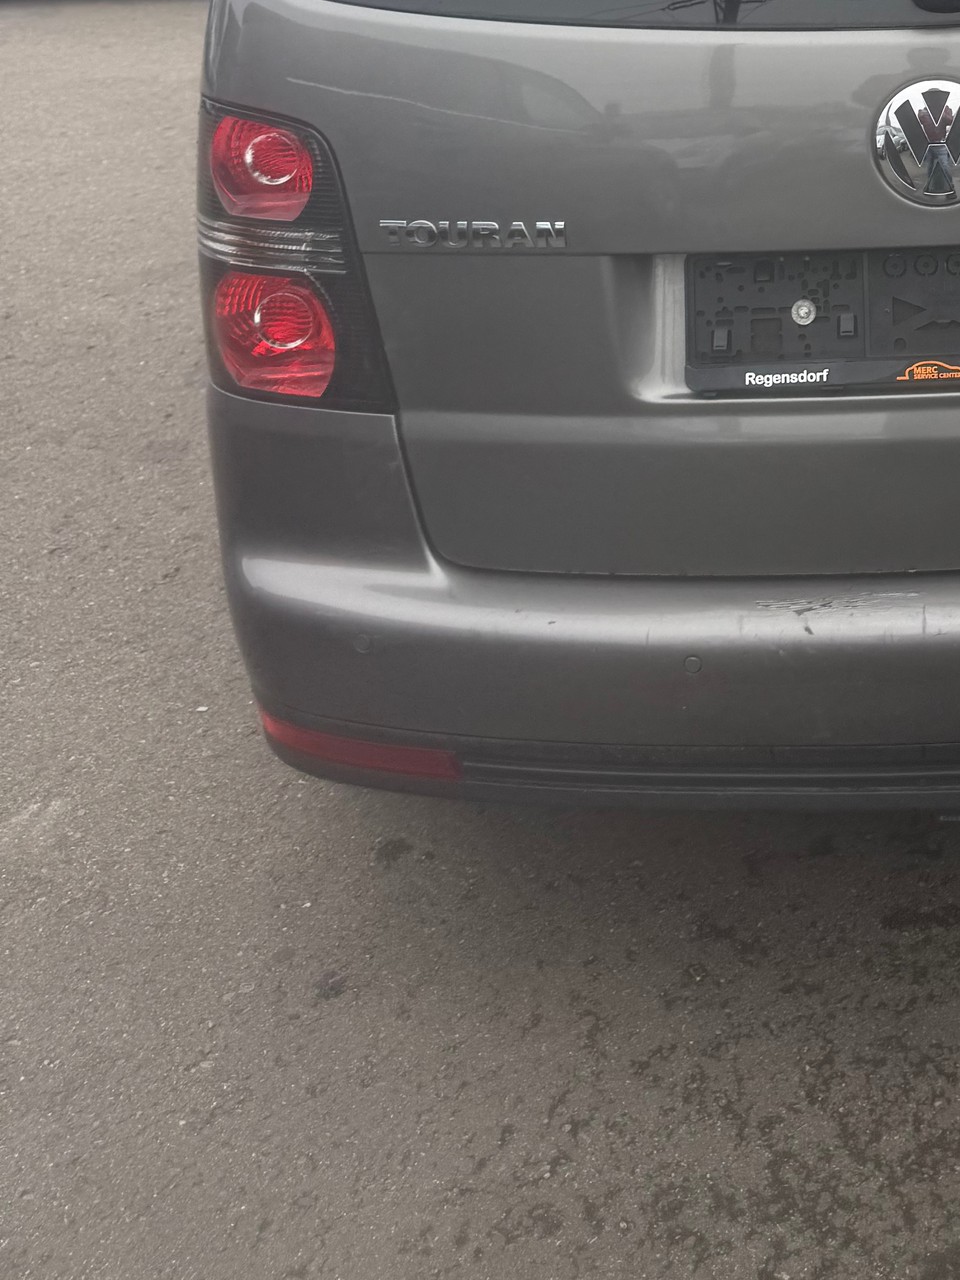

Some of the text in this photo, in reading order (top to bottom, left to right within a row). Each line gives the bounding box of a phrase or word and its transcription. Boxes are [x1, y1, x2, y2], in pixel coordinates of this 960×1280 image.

[379, 219, 567, 248] TOURAN
[745, 369, 830, 388] Regensdorf
[913, 366, 939, 375] MERC
